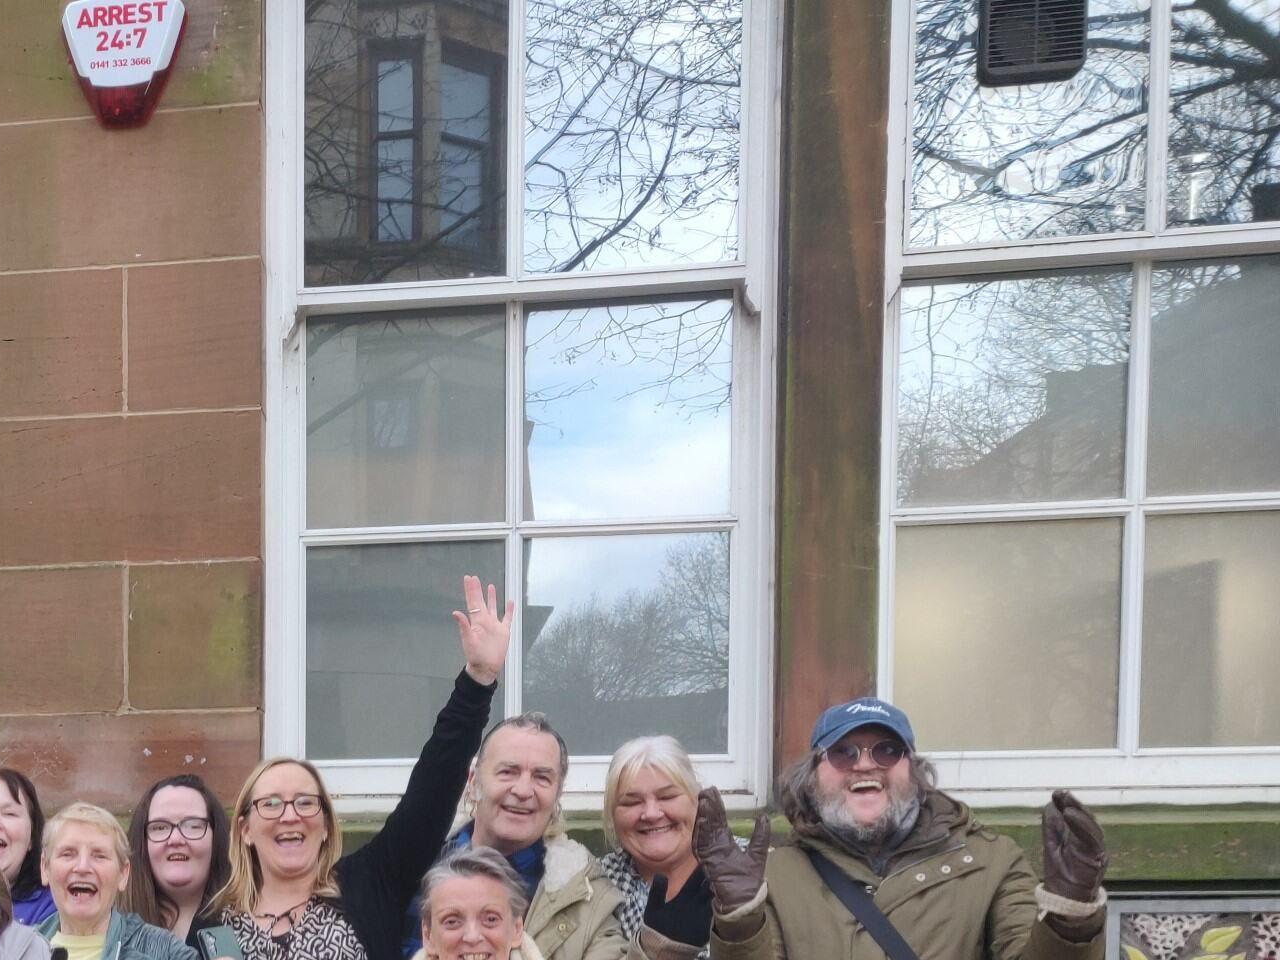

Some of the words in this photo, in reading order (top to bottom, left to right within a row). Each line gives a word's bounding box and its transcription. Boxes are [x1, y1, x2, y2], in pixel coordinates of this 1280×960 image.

[77, 1, 168, 29] ARREST
[96, 28, 147, 52] 24:7
[90, 60, 110, 70] 0141
[112, 59, 128, 68] 332
[130, 57, 152, 67] 3666
